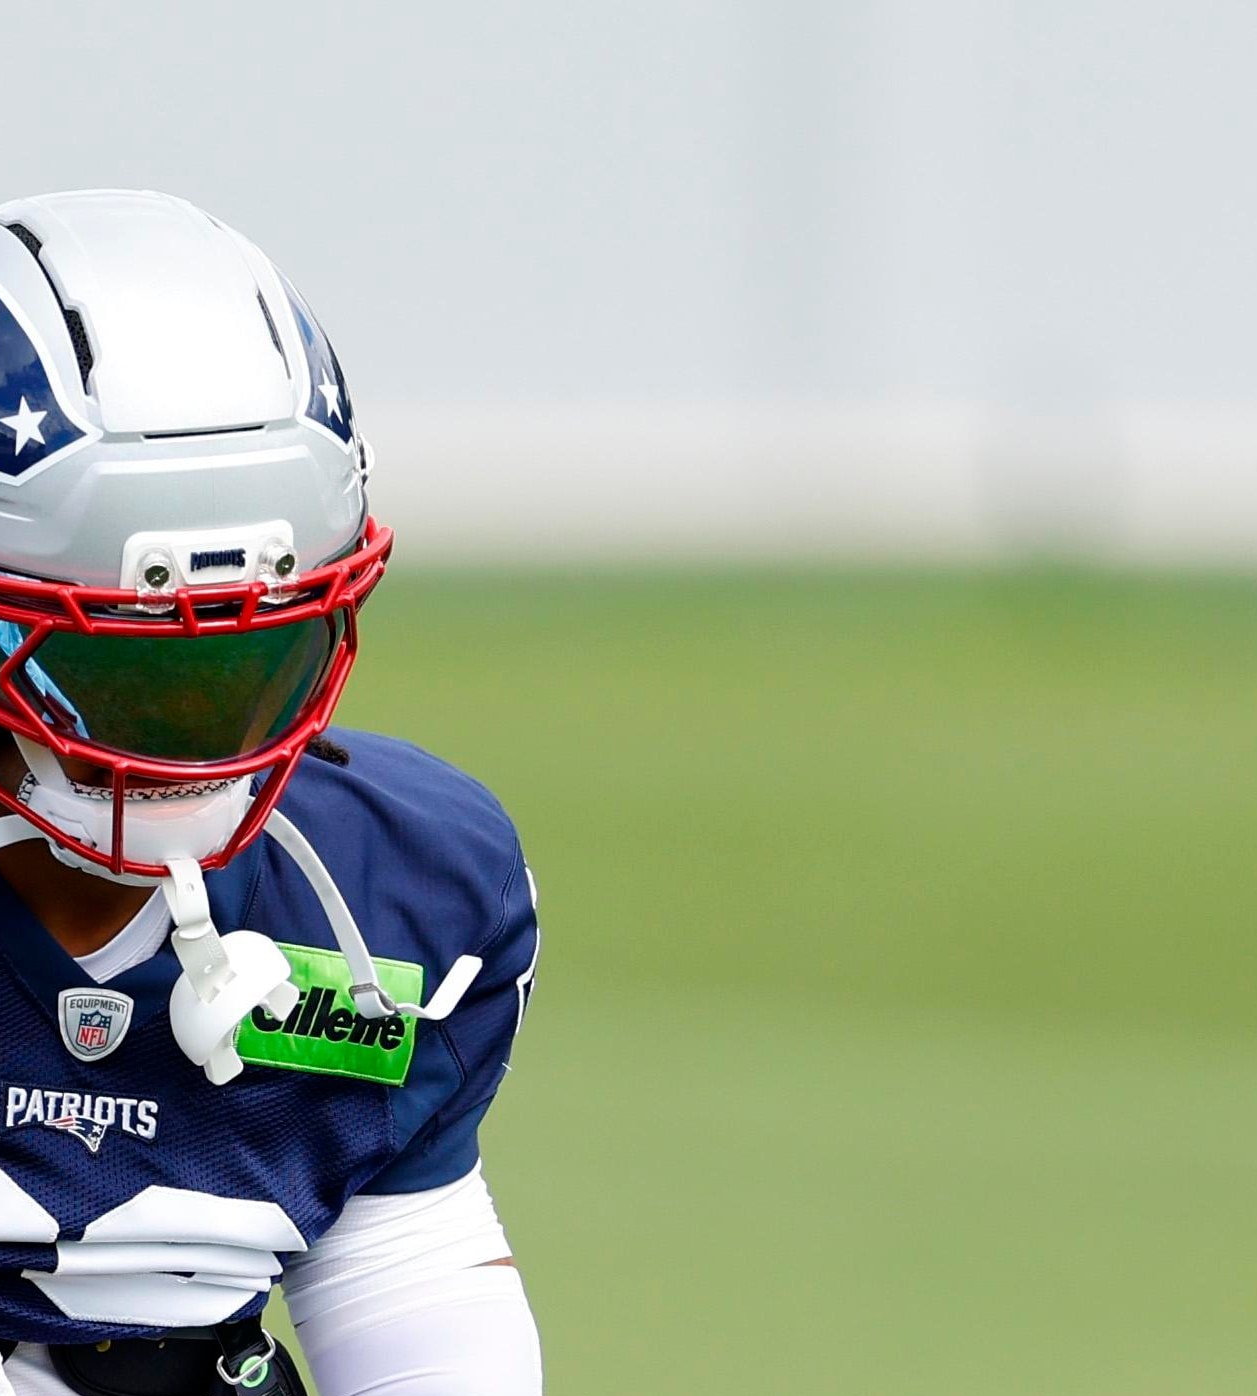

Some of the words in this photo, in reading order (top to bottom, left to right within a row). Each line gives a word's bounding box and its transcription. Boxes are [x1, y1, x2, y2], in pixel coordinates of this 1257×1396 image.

[69, 998, 126, 1014] EQUIPMENT
[79, 1026, 105, 1047] NFL
[6, 1086, 159, 1139] PATRIOTS
